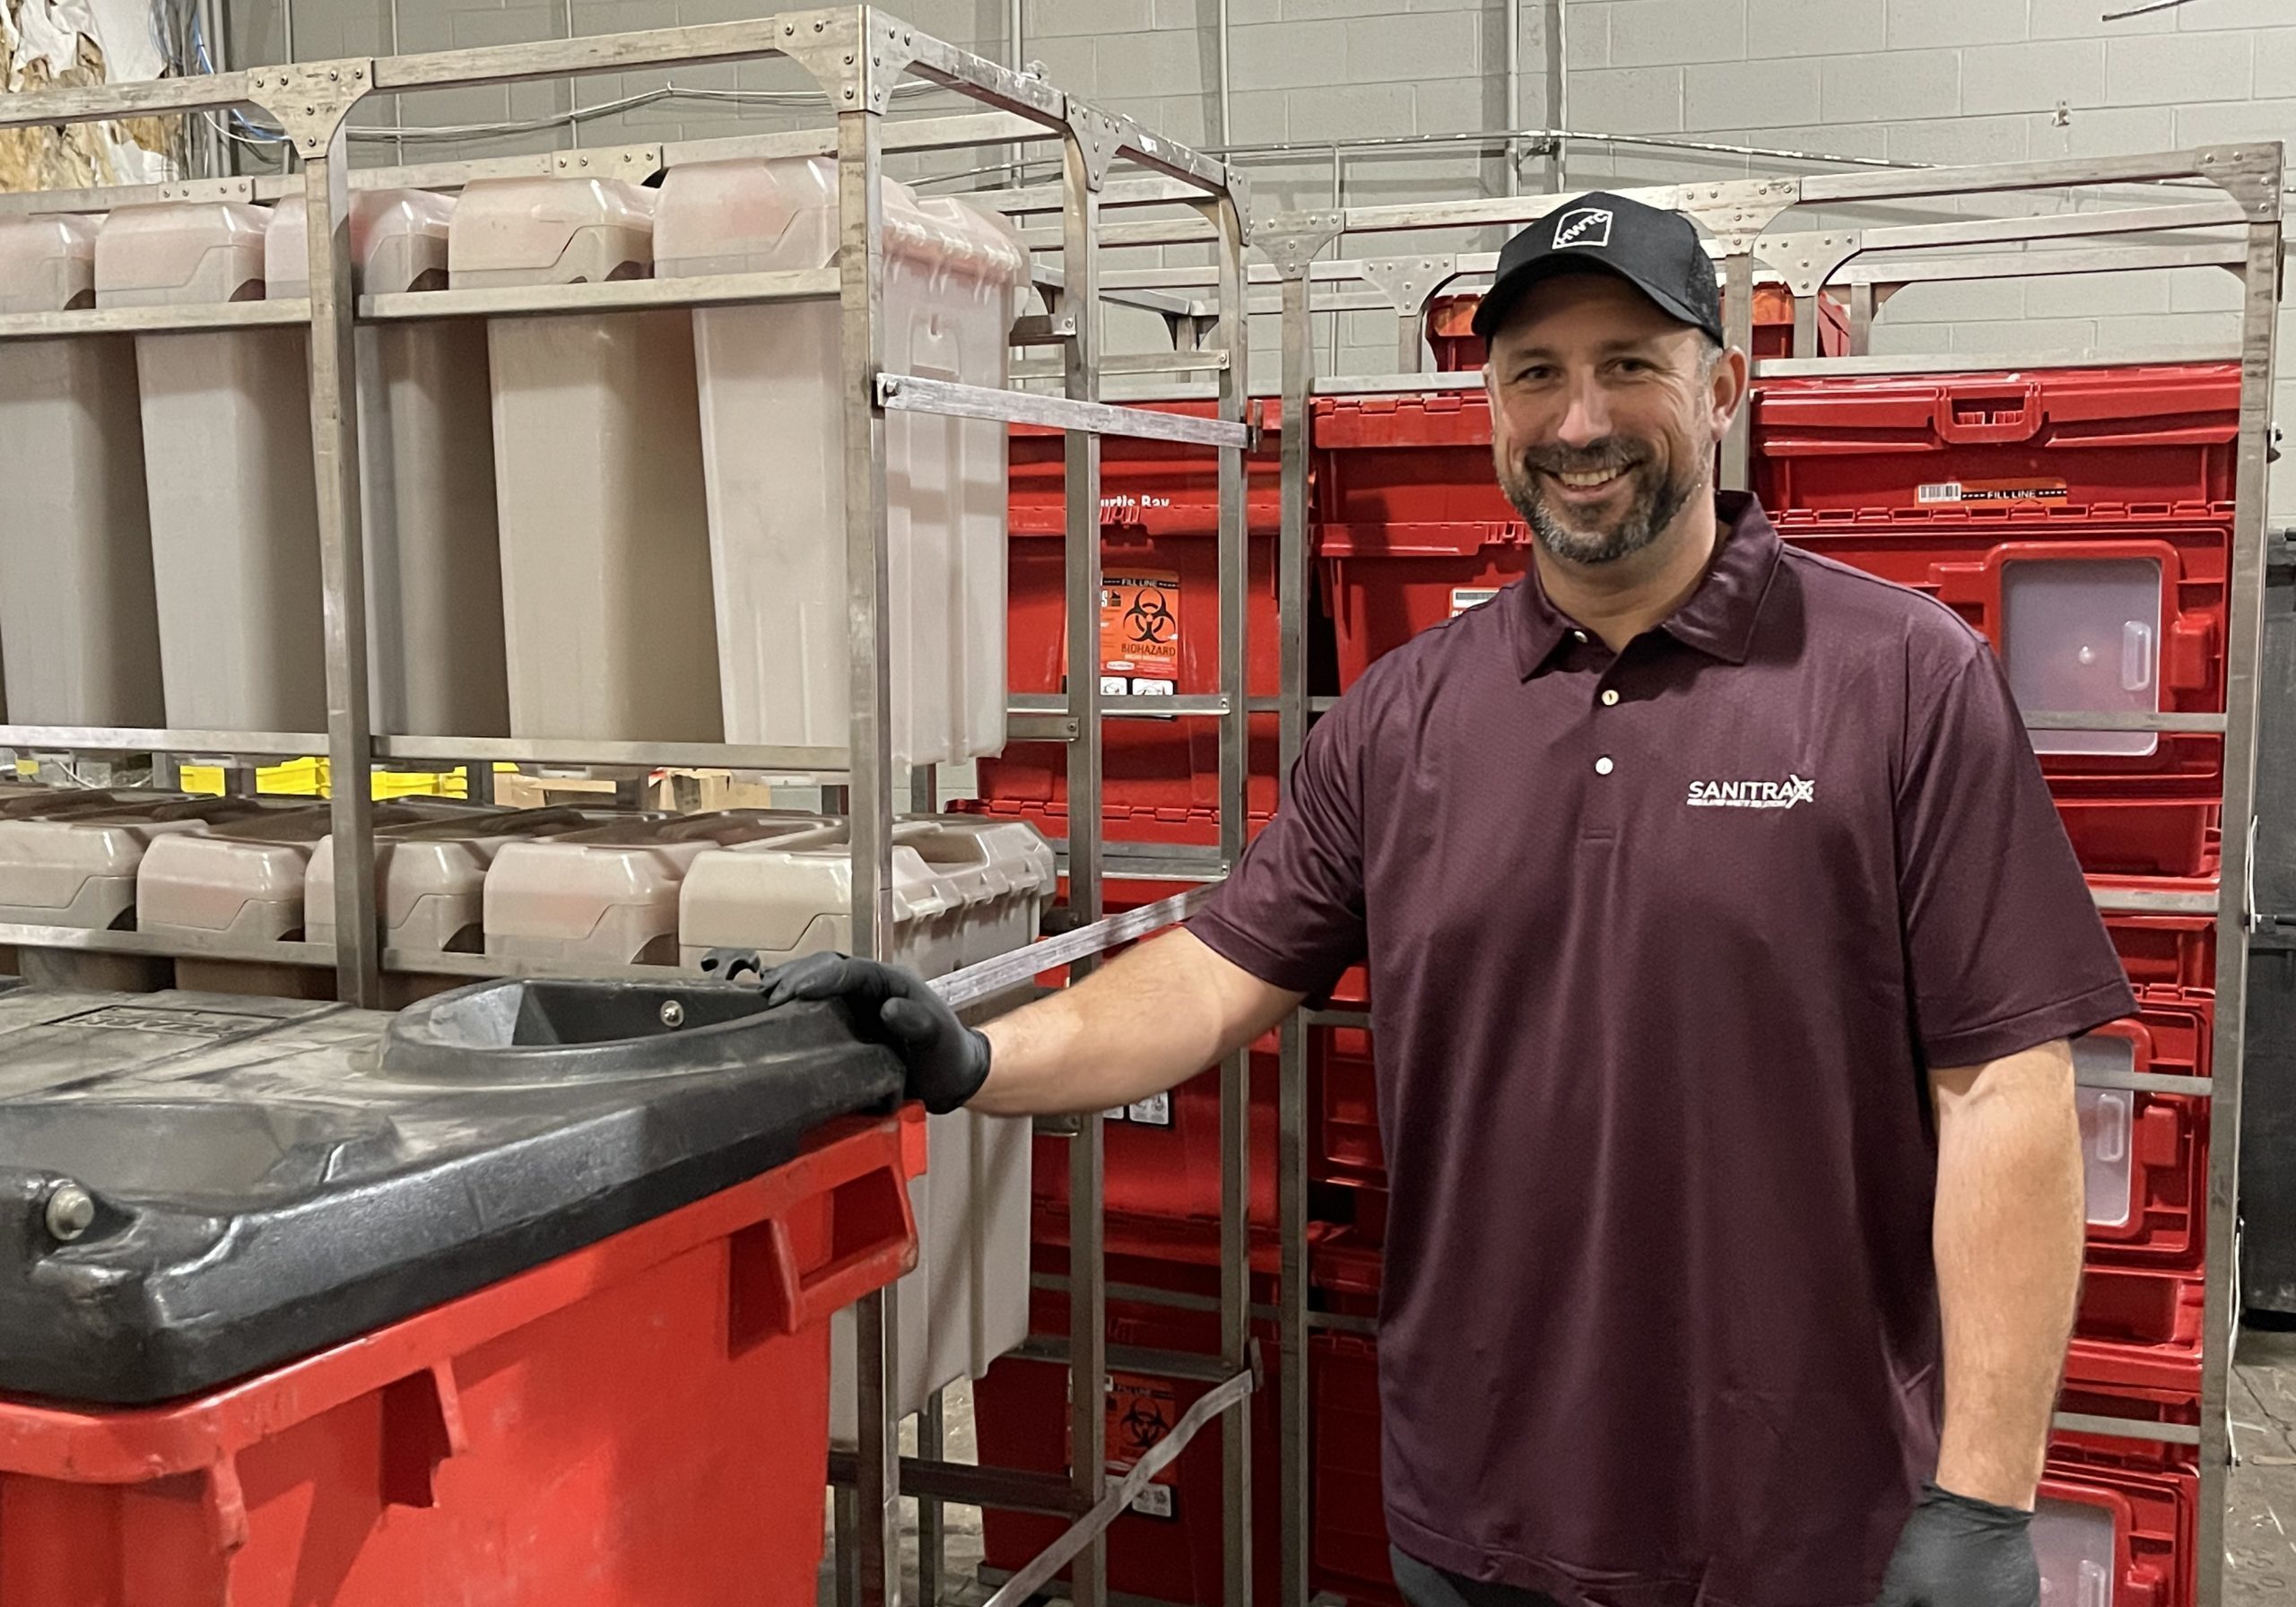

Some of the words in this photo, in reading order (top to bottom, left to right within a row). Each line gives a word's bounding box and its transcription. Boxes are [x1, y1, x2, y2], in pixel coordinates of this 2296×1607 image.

[1987, 491, 2010, 499] FILL
[2011, 490, 2036, 499] LINE
[1121, 578, 1137, 587] FILL
[1138, 578, 1158, 588] LINE
[1120, 643, 1176, 657] BIOHAZARD
